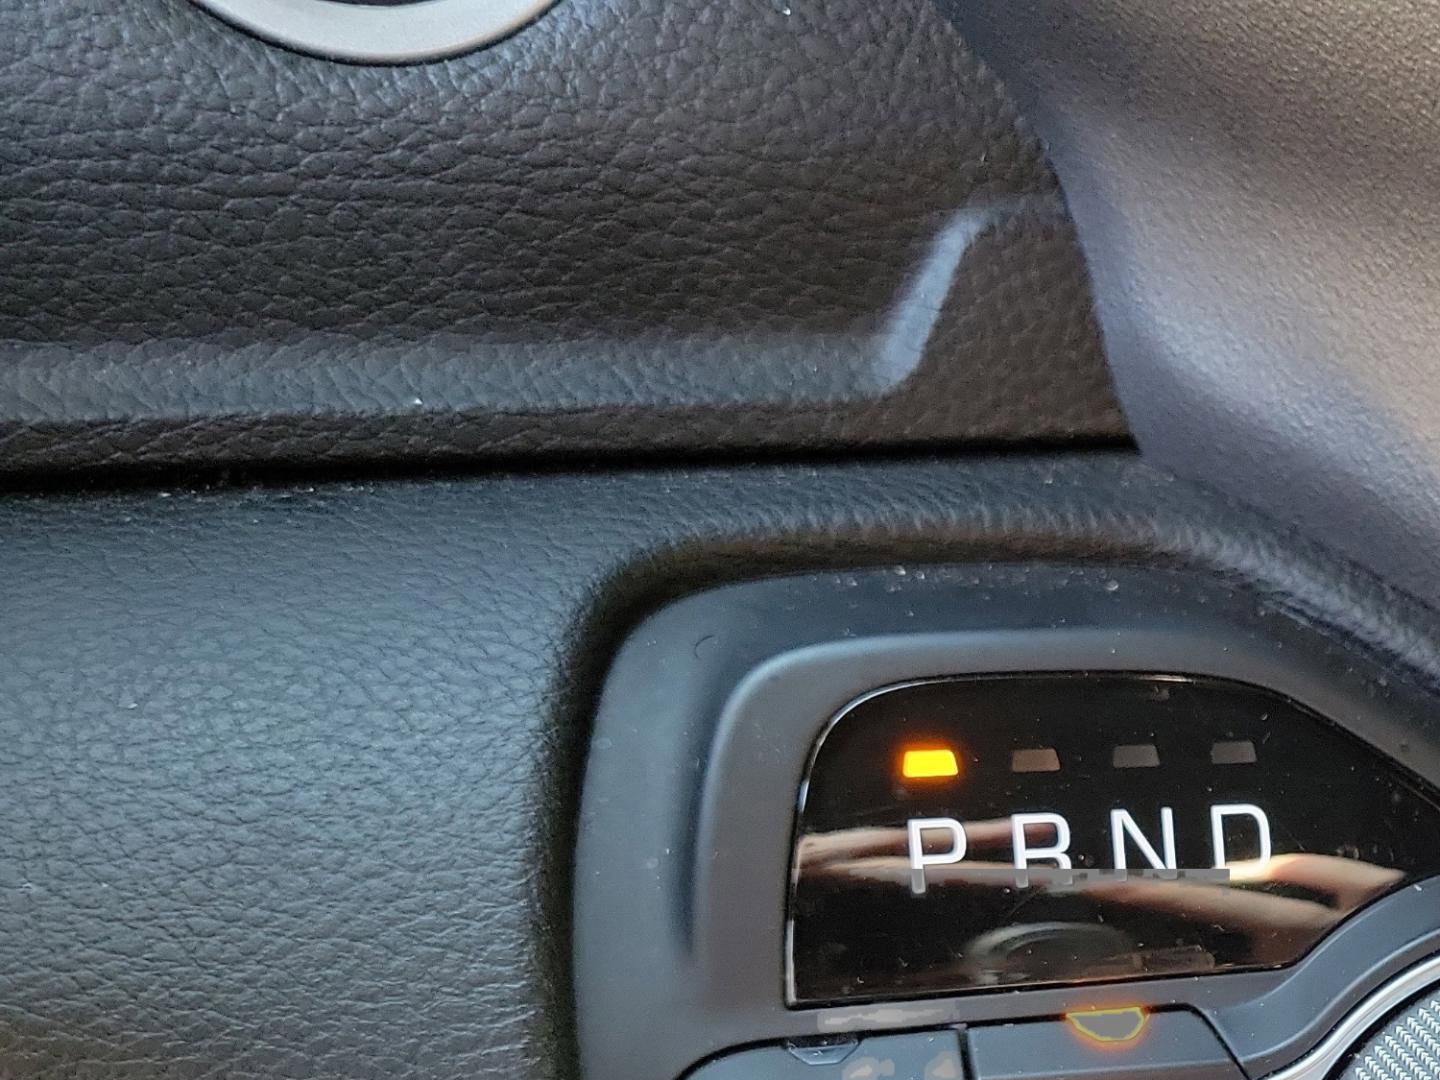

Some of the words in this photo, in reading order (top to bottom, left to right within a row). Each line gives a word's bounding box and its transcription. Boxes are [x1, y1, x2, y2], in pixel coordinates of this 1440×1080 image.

[907, 817, 967, 894] P
[1011, 812, 1074, 888] R
[1110, 806, 1178, 882] N
[1210, 803, 1272, 874] D
